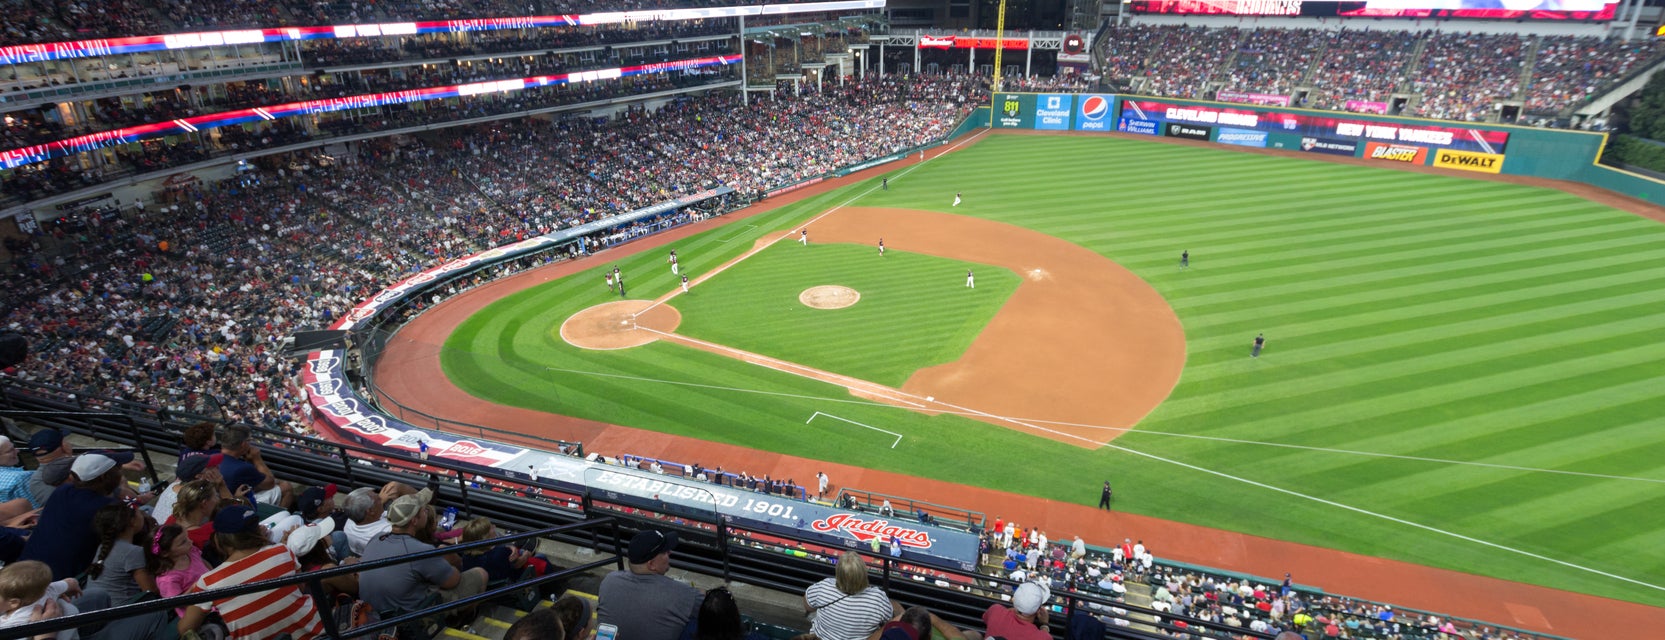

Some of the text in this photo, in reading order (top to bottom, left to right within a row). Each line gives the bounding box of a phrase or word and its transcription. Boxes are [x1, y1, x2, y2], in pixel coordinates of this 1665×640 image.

[1004, 101, 1019, 112] 811
[1036, 109, 1070, 117] Cleveland
[1082, 121, 1104, 129] pepsi
[1166, 108, 1217, 123] CLEVELAND
[1337, 123, 1364, 136] NEW
[1366, 125, 1397, 139] YORK
[1399, 128, 1453, 145] YANKEES
[1181, 128, 1207, 136] RAM
[1218, 133, 1267, 142] PROGRESSIVE
[1371, 145, 1418, 162] BLASTER
[356, 417, 387, 434] 2007
[448, 443, 481, 455] 2016
[596, 471, 798, 520] ESTABLISHED 1901.
[811, 514, 931, 548] Indians
